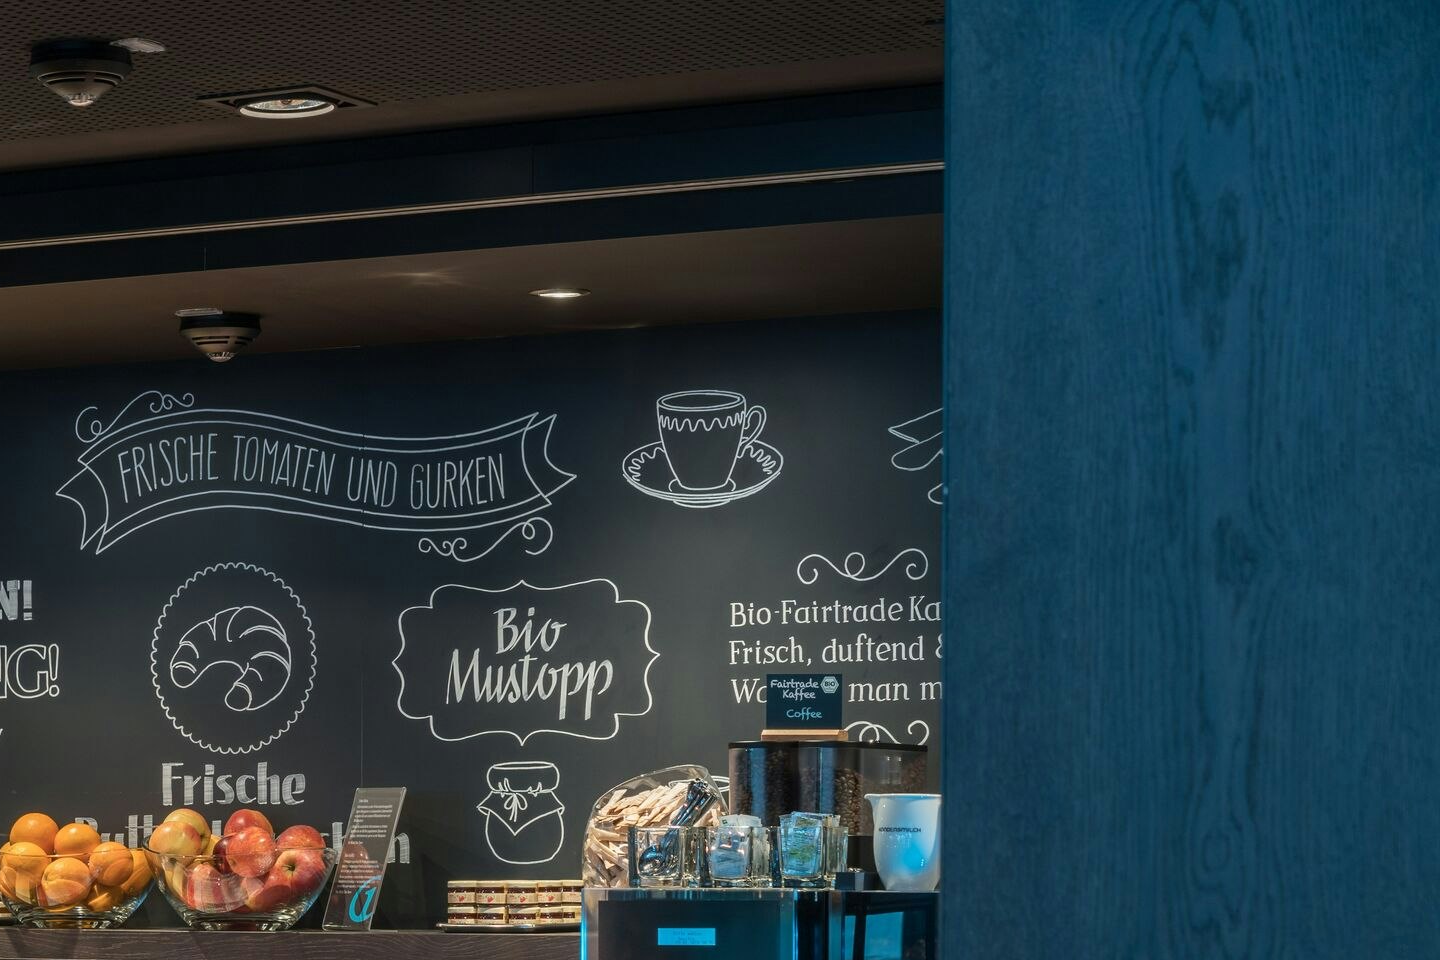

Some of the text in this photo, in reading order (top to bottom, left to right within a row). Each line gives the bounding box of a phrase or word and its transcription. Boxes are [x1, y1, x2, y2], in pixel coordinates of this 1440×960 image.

[117, 433, 506, 510] FRISCHE TOMATEN UND GURKEN
[729, 597, 903, 628] Bio-Fairtrade
[493, 606, 568, 655] Bio
[728, 636, 812, 666] Frisch,
[822, 633, 925, 664] duftend
[446, 648, 614, 720] Mustopp
[770, 678, 819, 689] Fairtrade
[782, 688, 816, 700] Kaffee
[848, 681, 910, 702] man
[786, 706, 822, 720] Coffee
[161, 761, 307, 806] Frische
